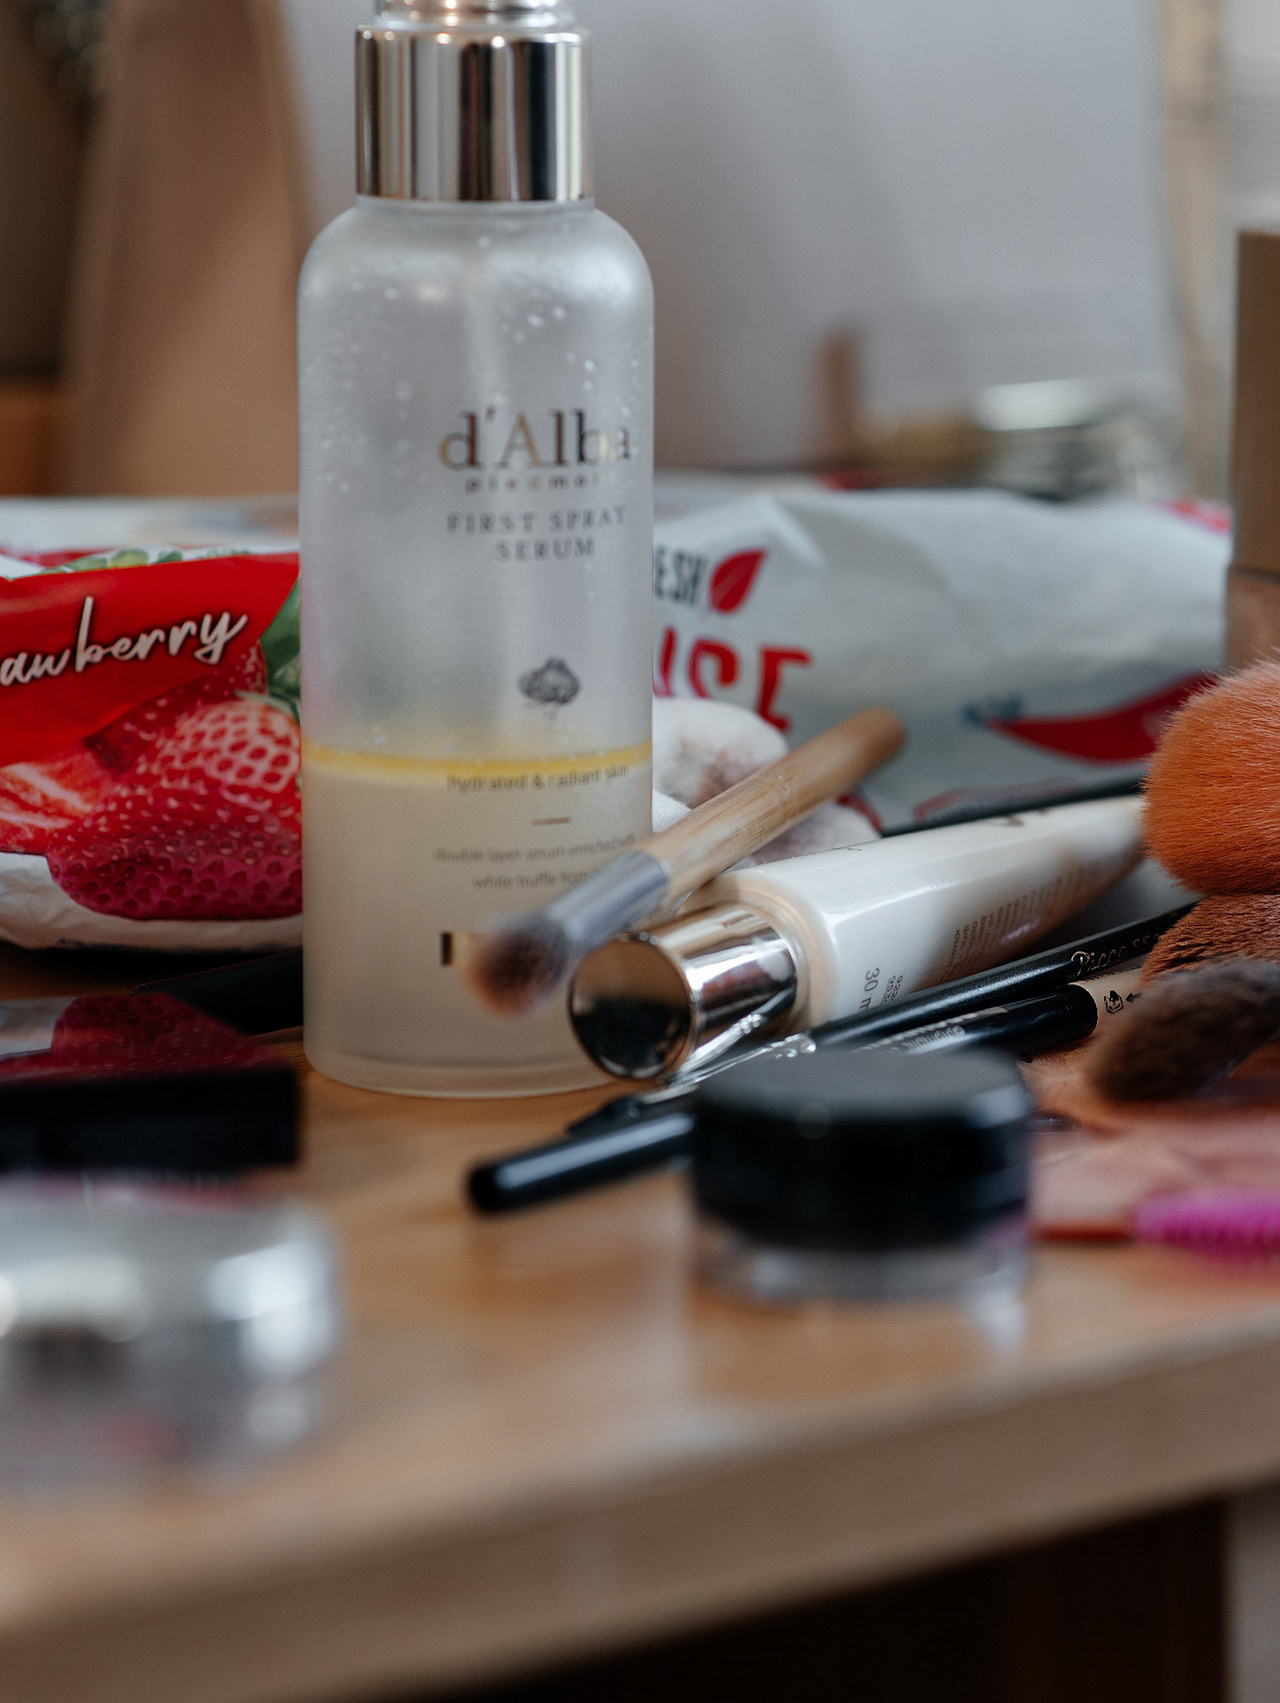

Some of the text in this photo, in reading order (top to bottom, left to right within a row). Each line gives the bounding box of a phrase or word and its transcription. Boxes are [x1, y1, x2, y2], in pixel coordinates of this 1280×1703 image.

[438, 404, 632, 471] d'Alba
[447, 504, 626, 535] FIRST SPRAY
[495, 536, 595, 562] SERUM
[655, 546, 706, 607] ESH
[0, 596, 248, 686] awberry
[447, 764, 629, 794] hydrated & radiant skin
[432, 848, 484, 863] double
[488, 848, 522, 863] layer
[472, 874, 513, 890] white
[516, 870, 557, 888] truffle
[858, 967, 880, 1010] 30 m
